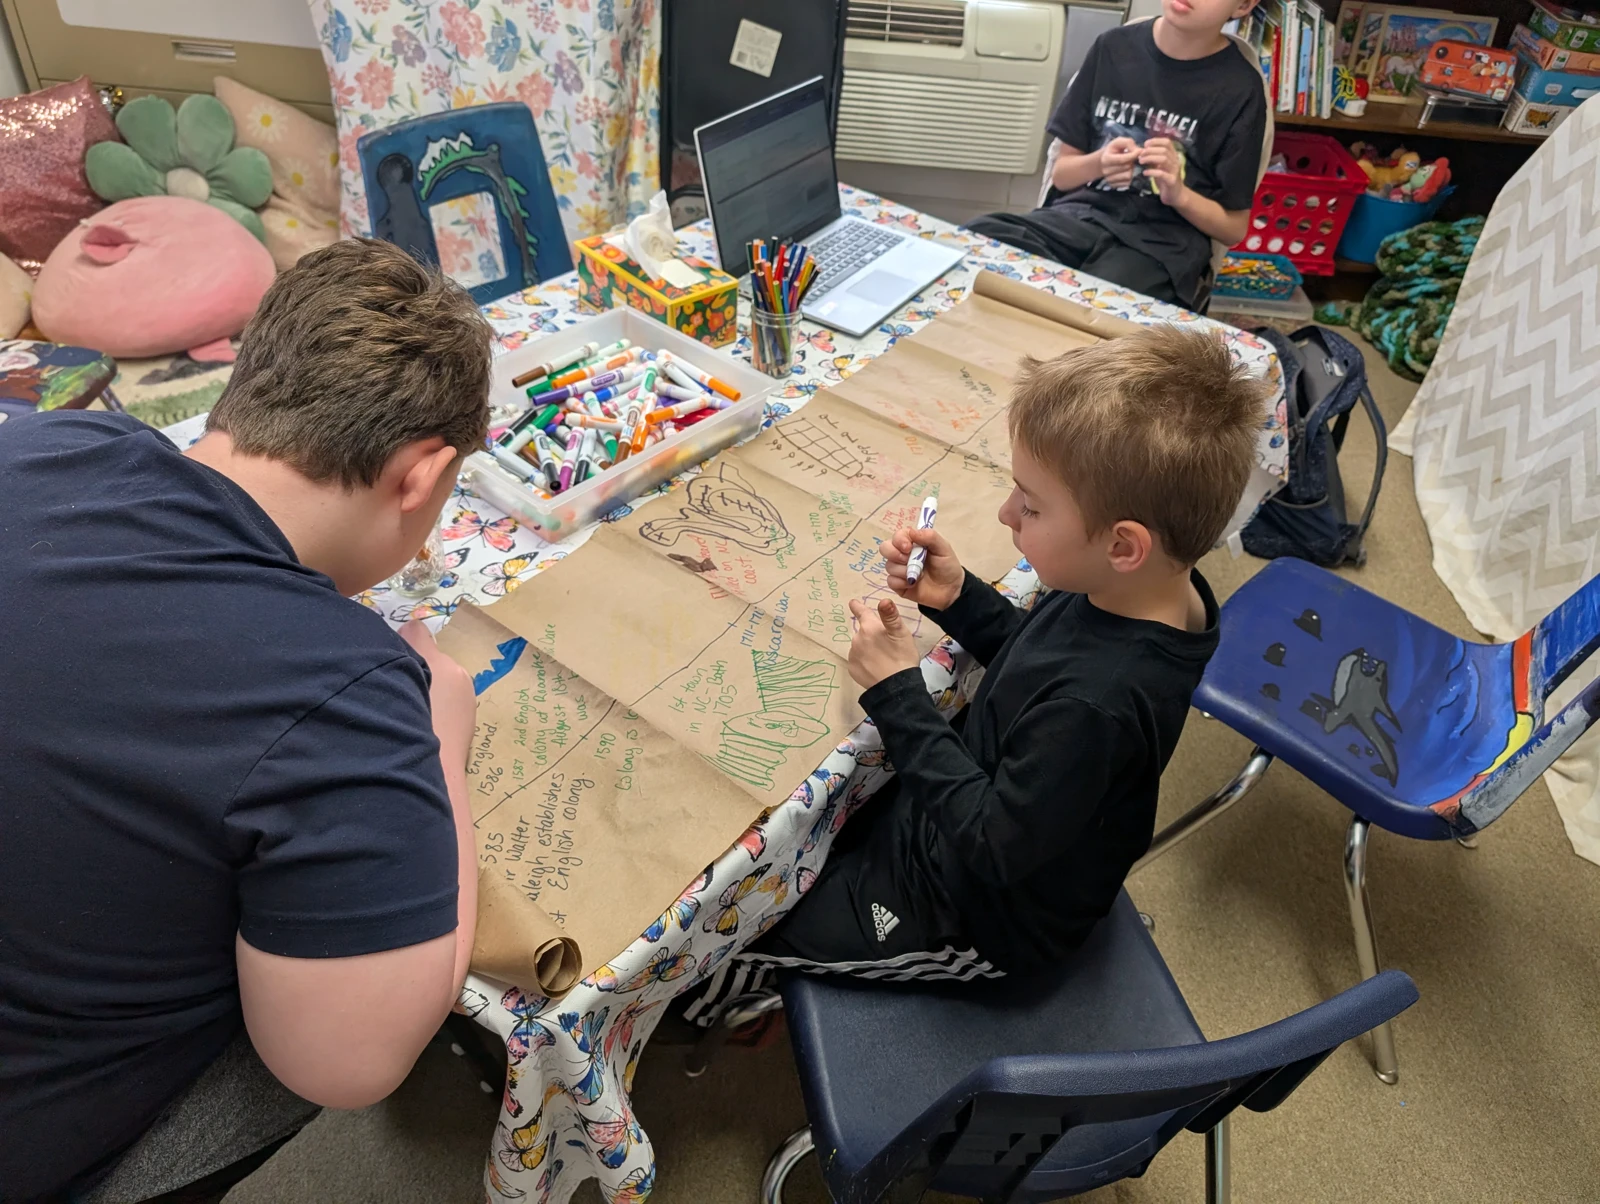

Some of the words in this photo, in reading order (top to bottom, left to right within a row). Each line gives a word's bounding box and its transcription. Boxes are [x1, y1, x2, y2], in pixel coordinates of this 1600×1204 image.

[1095, 96, 1141, 125] NEXT
[1145, 107, 1199, 142] LEVEL
[845, 538, 862, 556] 1771
[849, 548, 878, 572] Battle
[775, 591, 790, 613] War
[807, 576, 824, 601] Fort
[808, 608, 824, 633] 1755
[668, 696, 687, 713] 1st
[680, 667, 708, 692] town
[713, 685, 737, 715] 1705
[514, 688, 537, 725] English
[536, 710, 548, 724] at
[575, 694, 588, 721] was
[514, 728, 527, 747] 2nd
[686, 722, 702, 733] in
[594, 733, 616, 759] 1590
[477, 766, 503, 796] 1586
[513, 758, 524, 780] 1587
[535, 772, 565, 847] establishes
[480, 832, 504, 864] 585
[505, 815, 530, 861] Walter
[547, 829, 583, 890] English
[505, 869, 516, 881] ir
[522, 856, 556, 901] aleigh
[871, 903, 886, 942] adidas
